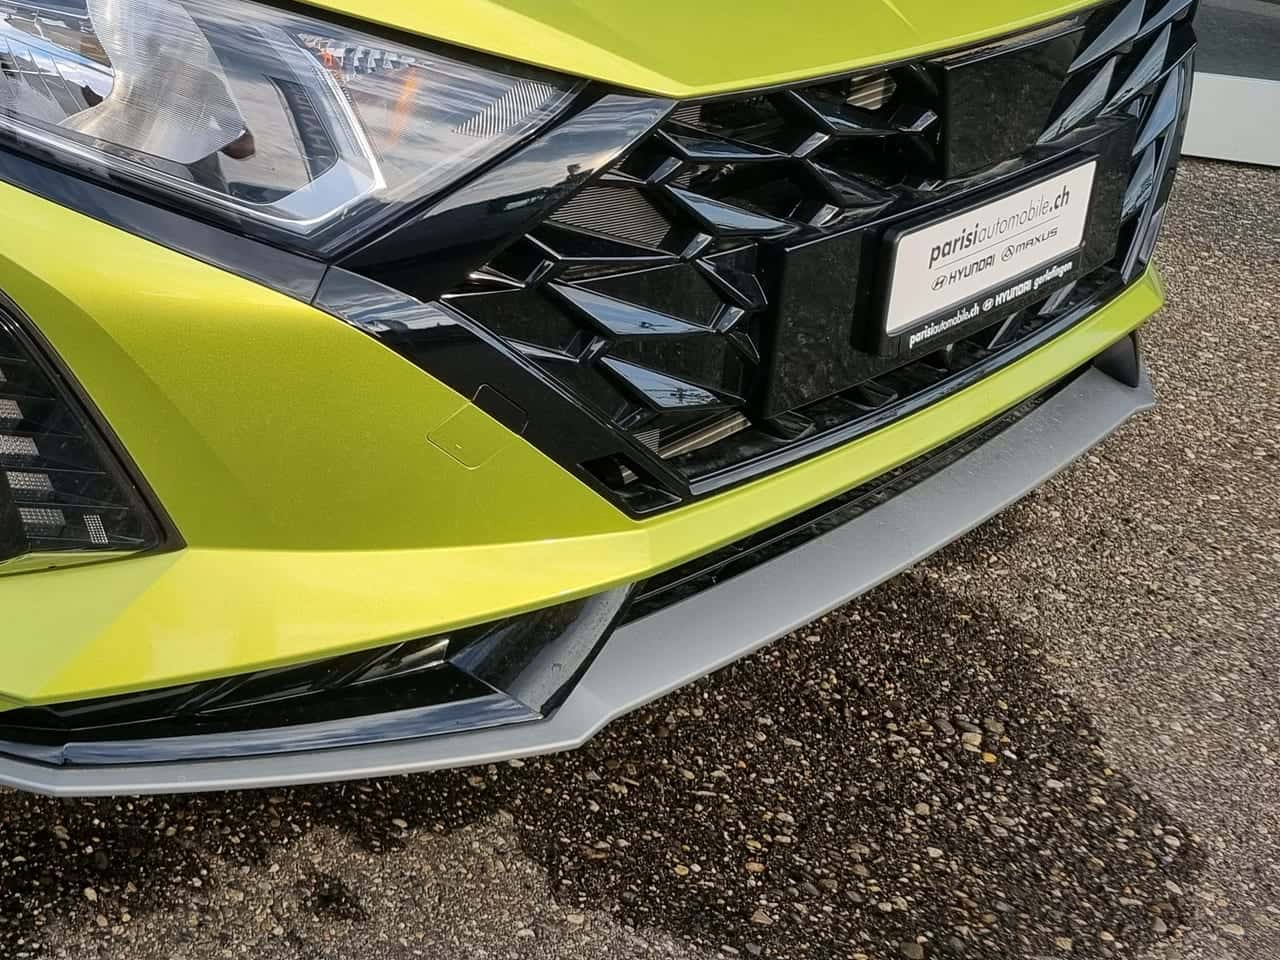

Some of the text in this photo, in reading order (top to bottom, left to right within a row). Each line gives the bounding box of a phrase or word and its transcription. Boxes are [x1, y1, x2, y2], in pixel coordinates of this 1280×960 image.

[928, 185, 1070, 269] parisiautomobile.ch
[948, 227, 1058, 285] HYUNDAI MAXUS
[909, 303, 980, 348] parisiautomobile.ch
[994, 279, 1032, 306] HYUNDAI
